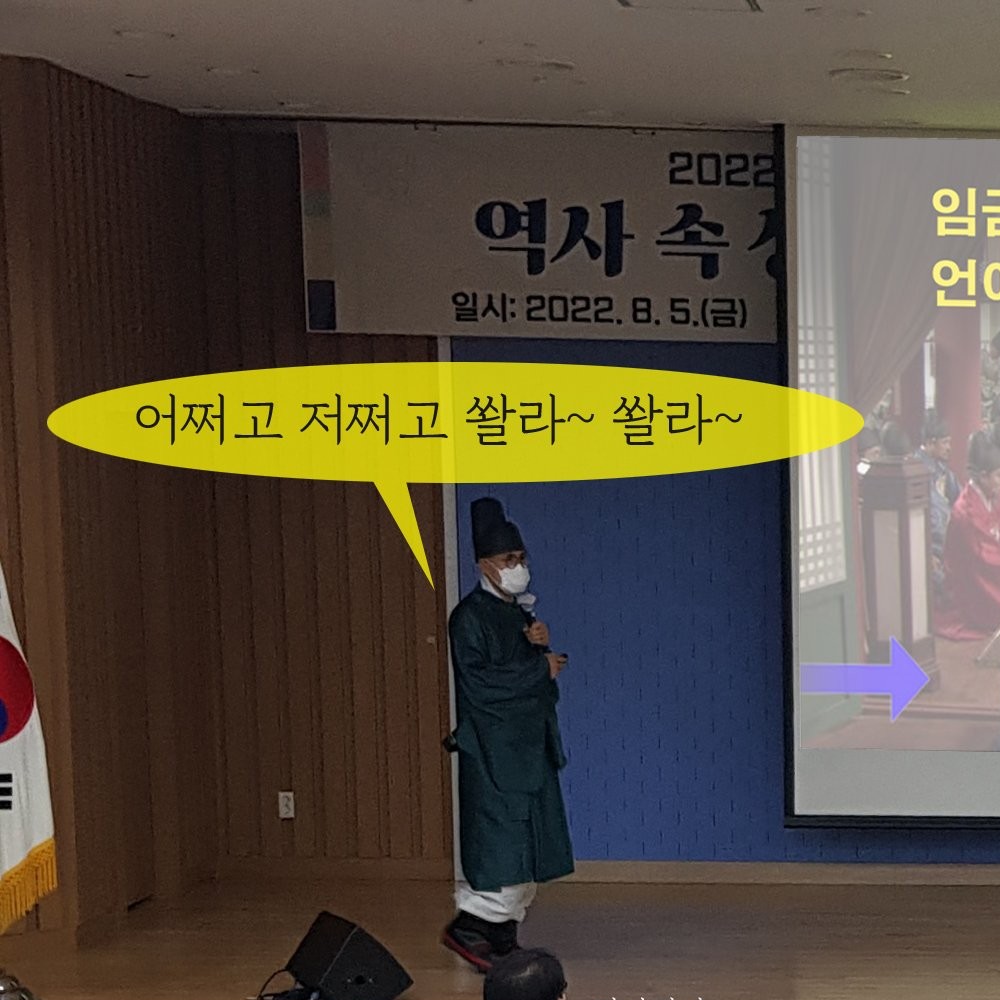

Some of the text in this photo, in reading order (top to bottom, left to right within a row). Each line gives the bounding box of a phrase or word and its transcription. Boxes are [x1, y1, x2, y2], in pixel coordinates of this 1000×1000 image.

[669, 152, 776, 187] 2022
[475, 198, 635, 277] 역사
[655, 203, 730, 280] 속
[451, 292, 517, 323] 일시:
